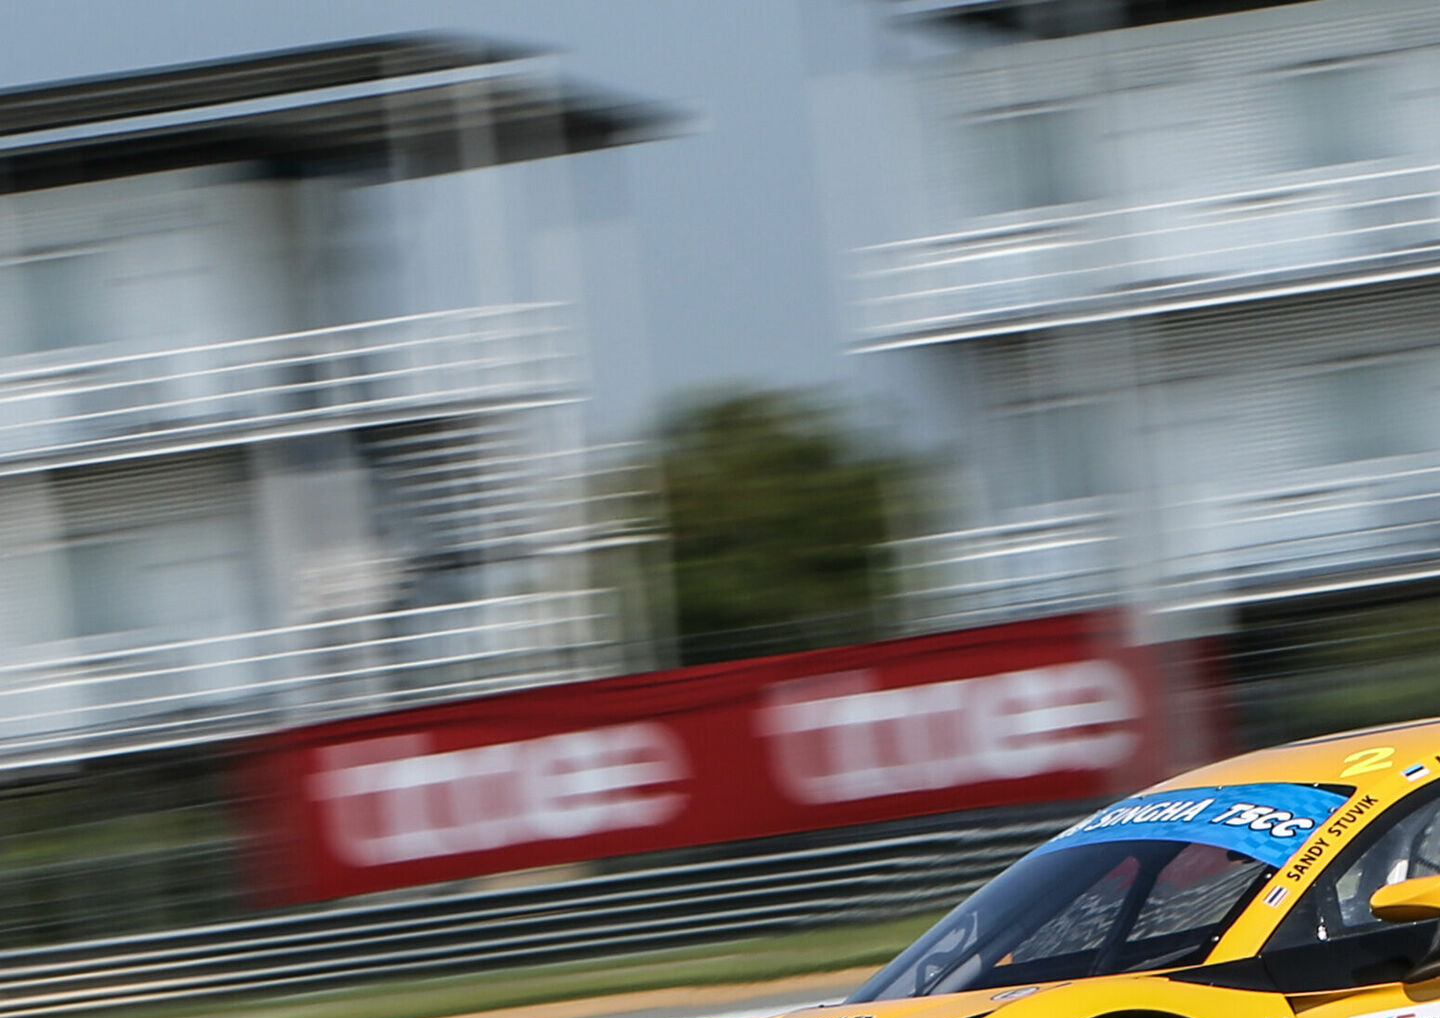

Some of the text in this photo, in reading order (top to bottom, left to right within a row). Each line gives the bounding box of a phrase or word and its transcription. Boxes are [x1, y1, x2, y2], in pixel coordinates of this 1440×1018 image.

[1340, 747, 1396, 778] 2
[1083, 798, 1216, 832] SINGHA
[1210, 802, 1315, 838] TSCC
[1286, 794, 1379, 882] SANDY STUVIK
